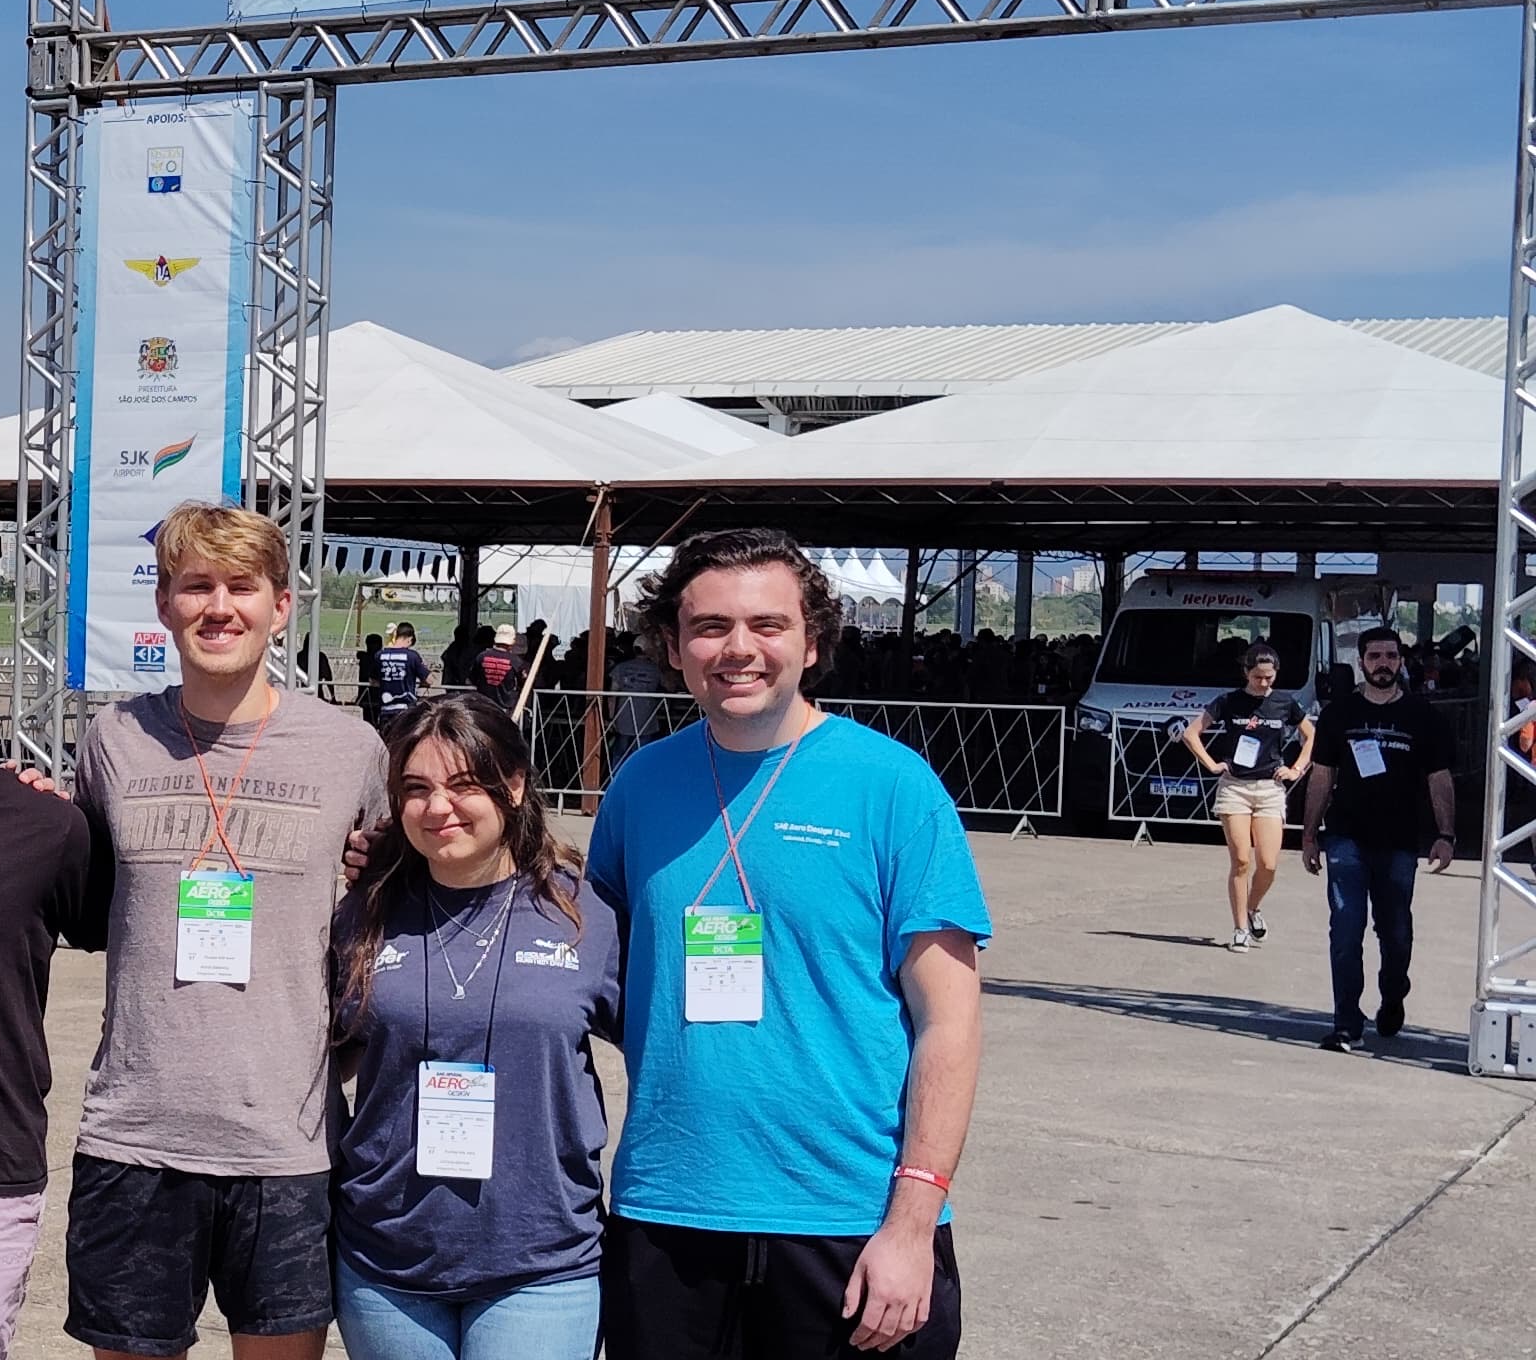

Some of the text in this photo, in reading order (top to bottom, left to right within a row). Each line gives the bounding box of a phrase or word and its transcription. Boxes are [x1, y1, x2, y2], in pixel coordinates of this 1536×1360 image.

[120, 450, 150, 466] SJK
[113, 468, 146, 478] AIRPORT
[125, 774, 195, 794] PURDUE
[186, 885, 231, 899] AERO
[691, 920, 737, 935] AERO
[425, 1076, 470, 1090] AERO
